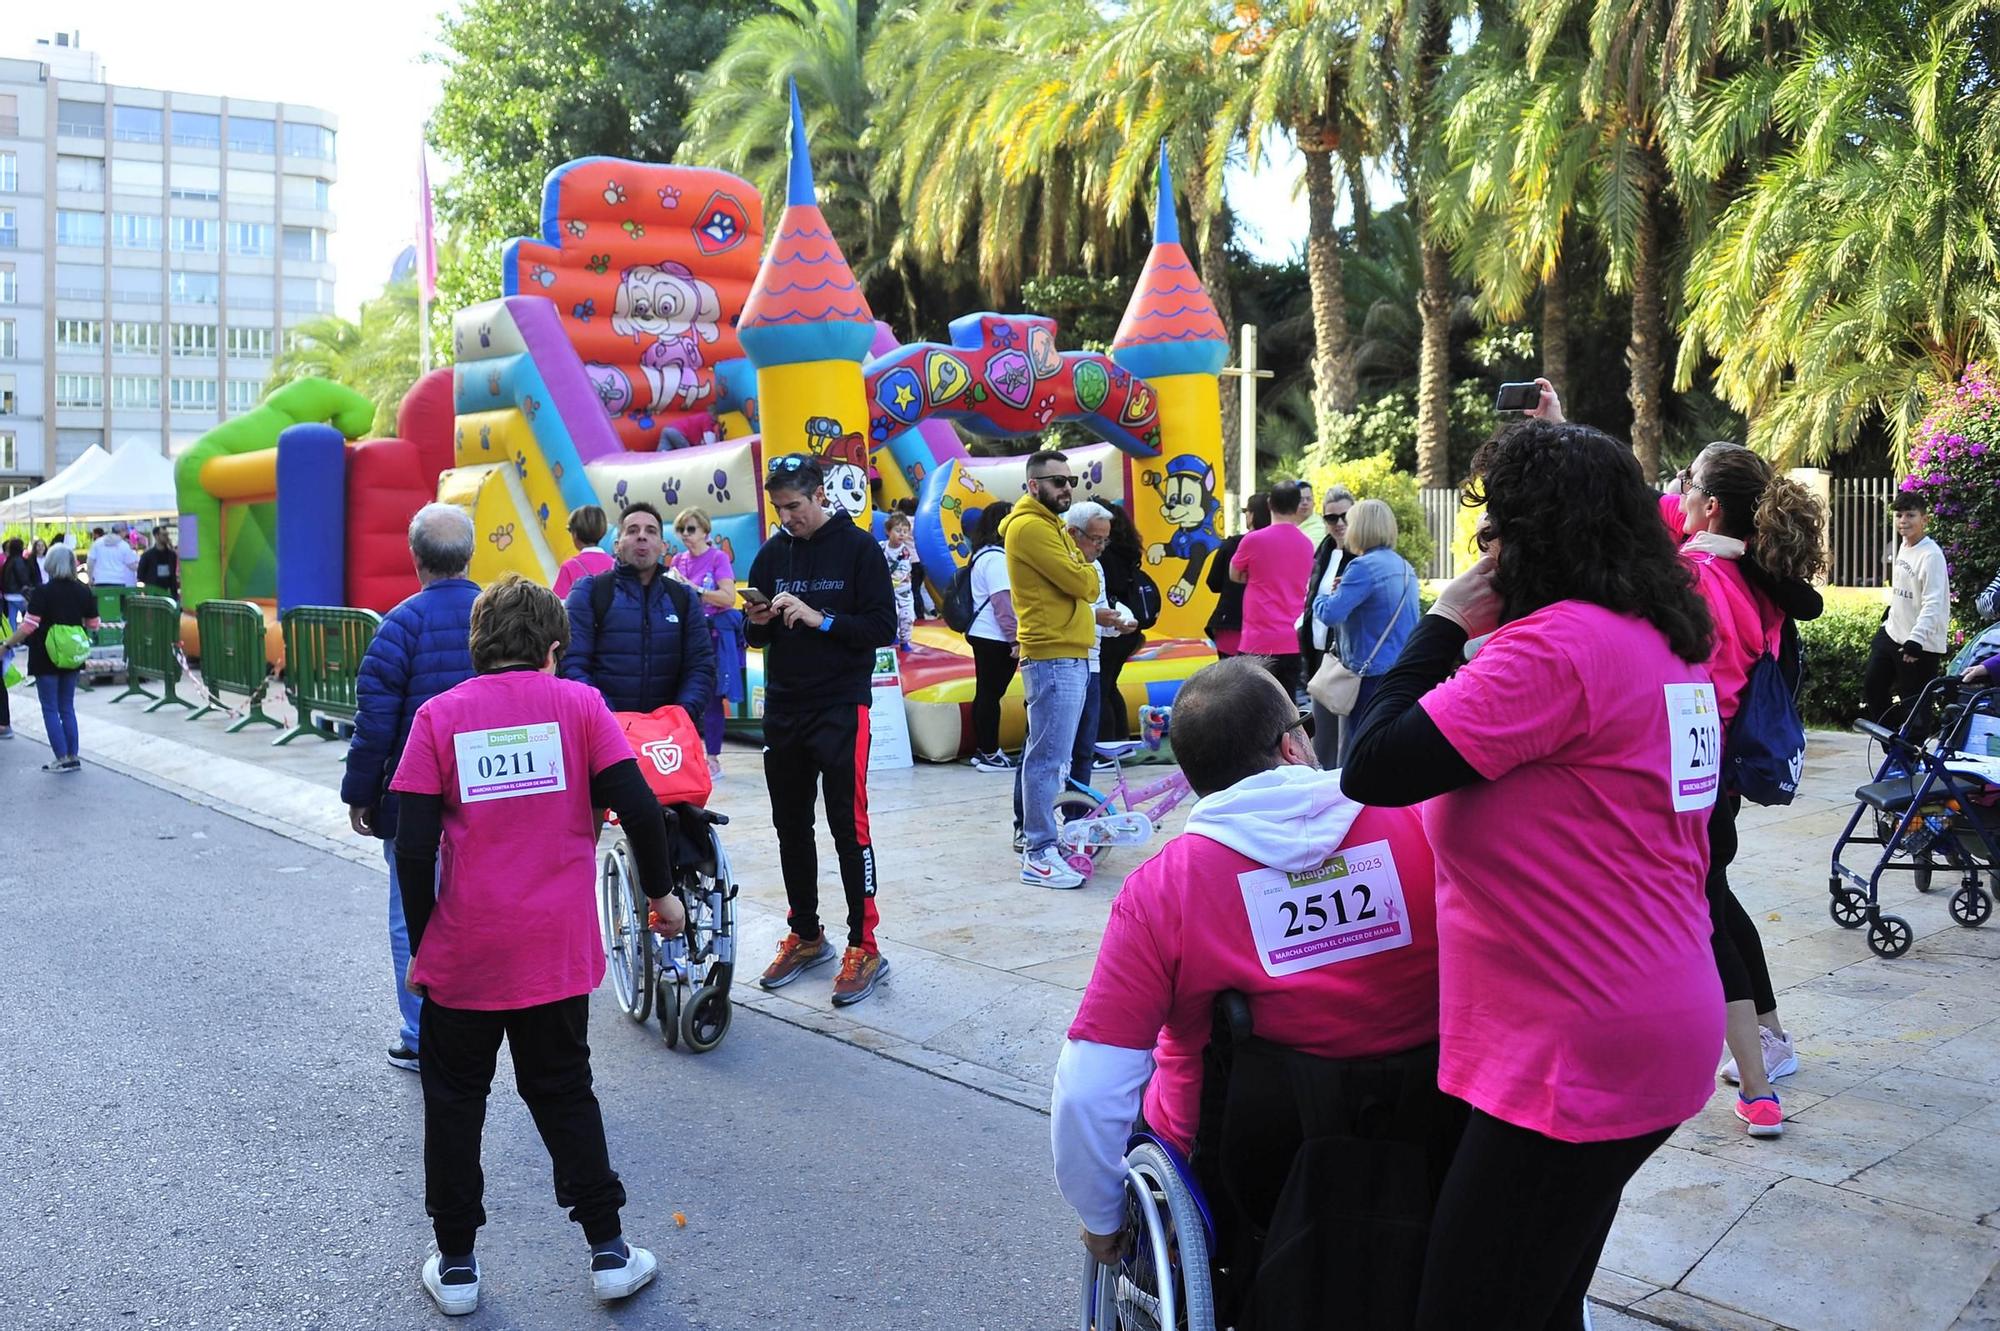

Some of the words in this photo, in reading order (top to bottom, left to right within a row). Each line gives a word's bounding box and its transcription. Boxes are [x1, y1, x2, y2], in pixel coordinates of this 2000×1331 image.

[478, 750, 536, 778] 0211
[863, 847, 874, 893] joma
[1291, 862, 1344, 882] Dialprix
[1349, 857, 1382, 874] 2023
[1278, 884, 1377, 938] 2512
[1275, 948, 1303, 960] MARCHA
[1303, 942, 1329, 953] CONTRA
[1337, 931, 1364, 944] CÁNCER
[1364, 930, 1373, 938] DE
[1373, 926, 1394, 937] MAMA
